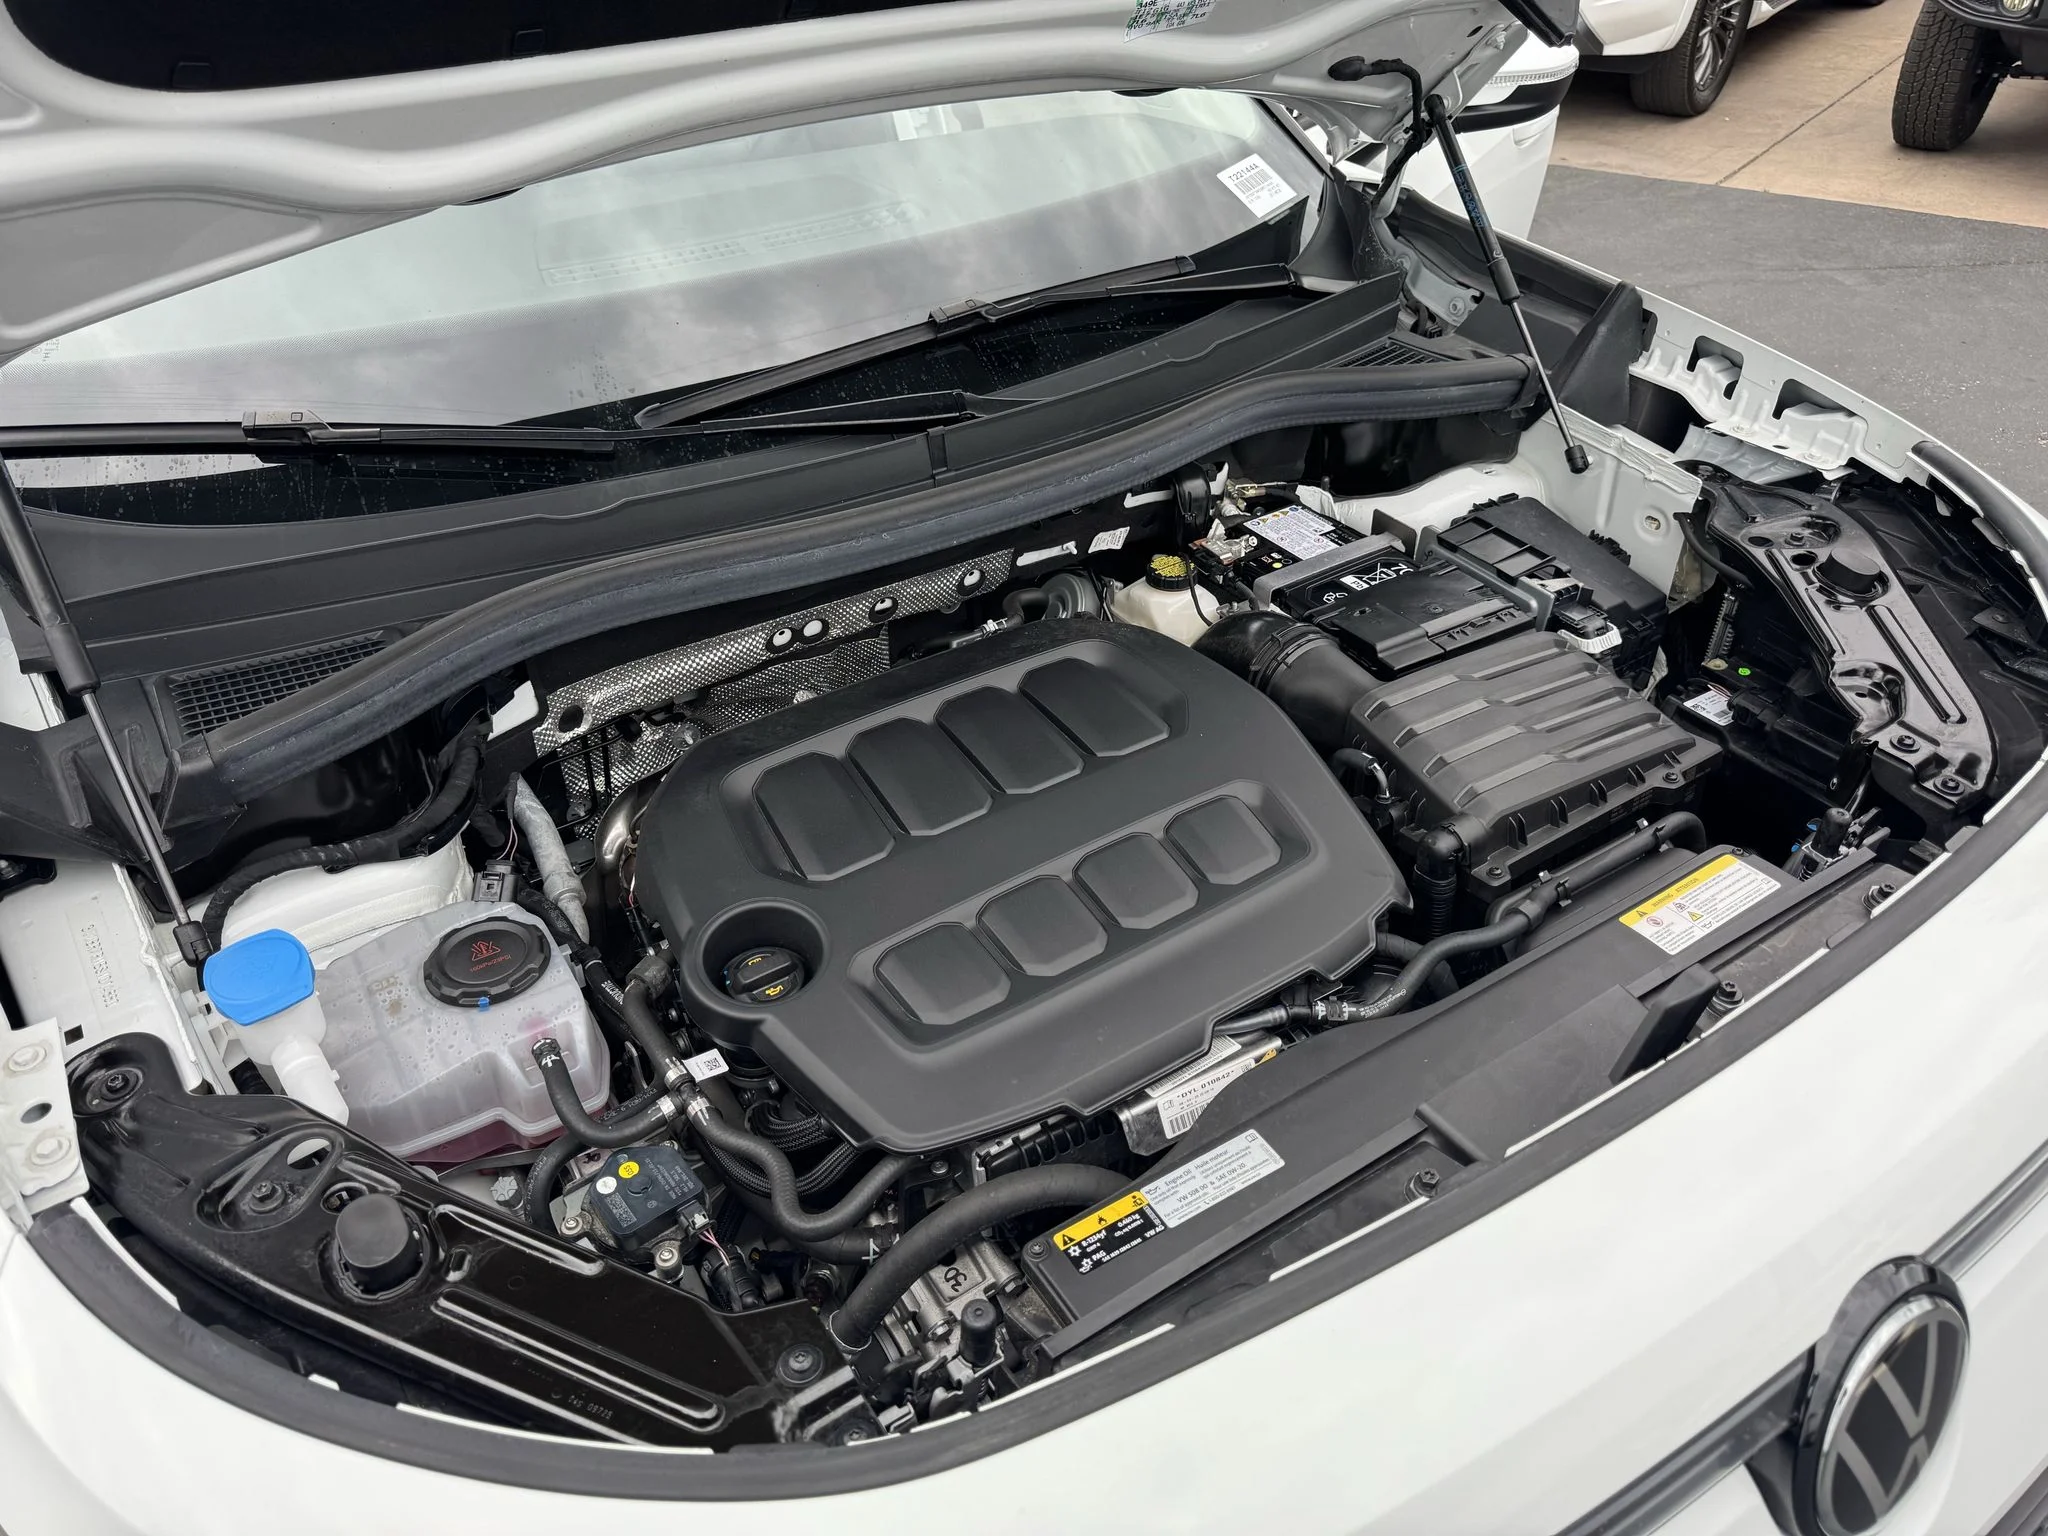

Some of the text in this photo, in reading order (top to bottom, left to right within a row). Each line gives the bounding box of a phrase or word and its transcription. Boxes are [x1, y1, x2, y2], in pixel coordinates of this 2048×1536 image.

[1195, 1149, 1228, 1169] Huile moteur
[1165, 1173, 1184, 1186] Engine
[1177, 1194, 1188, 1203] VW
[1216, 1173, 1227, 1181] SAE
[1081, 1230, 1107, 1247] R-1234yf
[1144, 1229, 1156, 1237] VW
[1092, 1250, 1106, 1261] PAG
